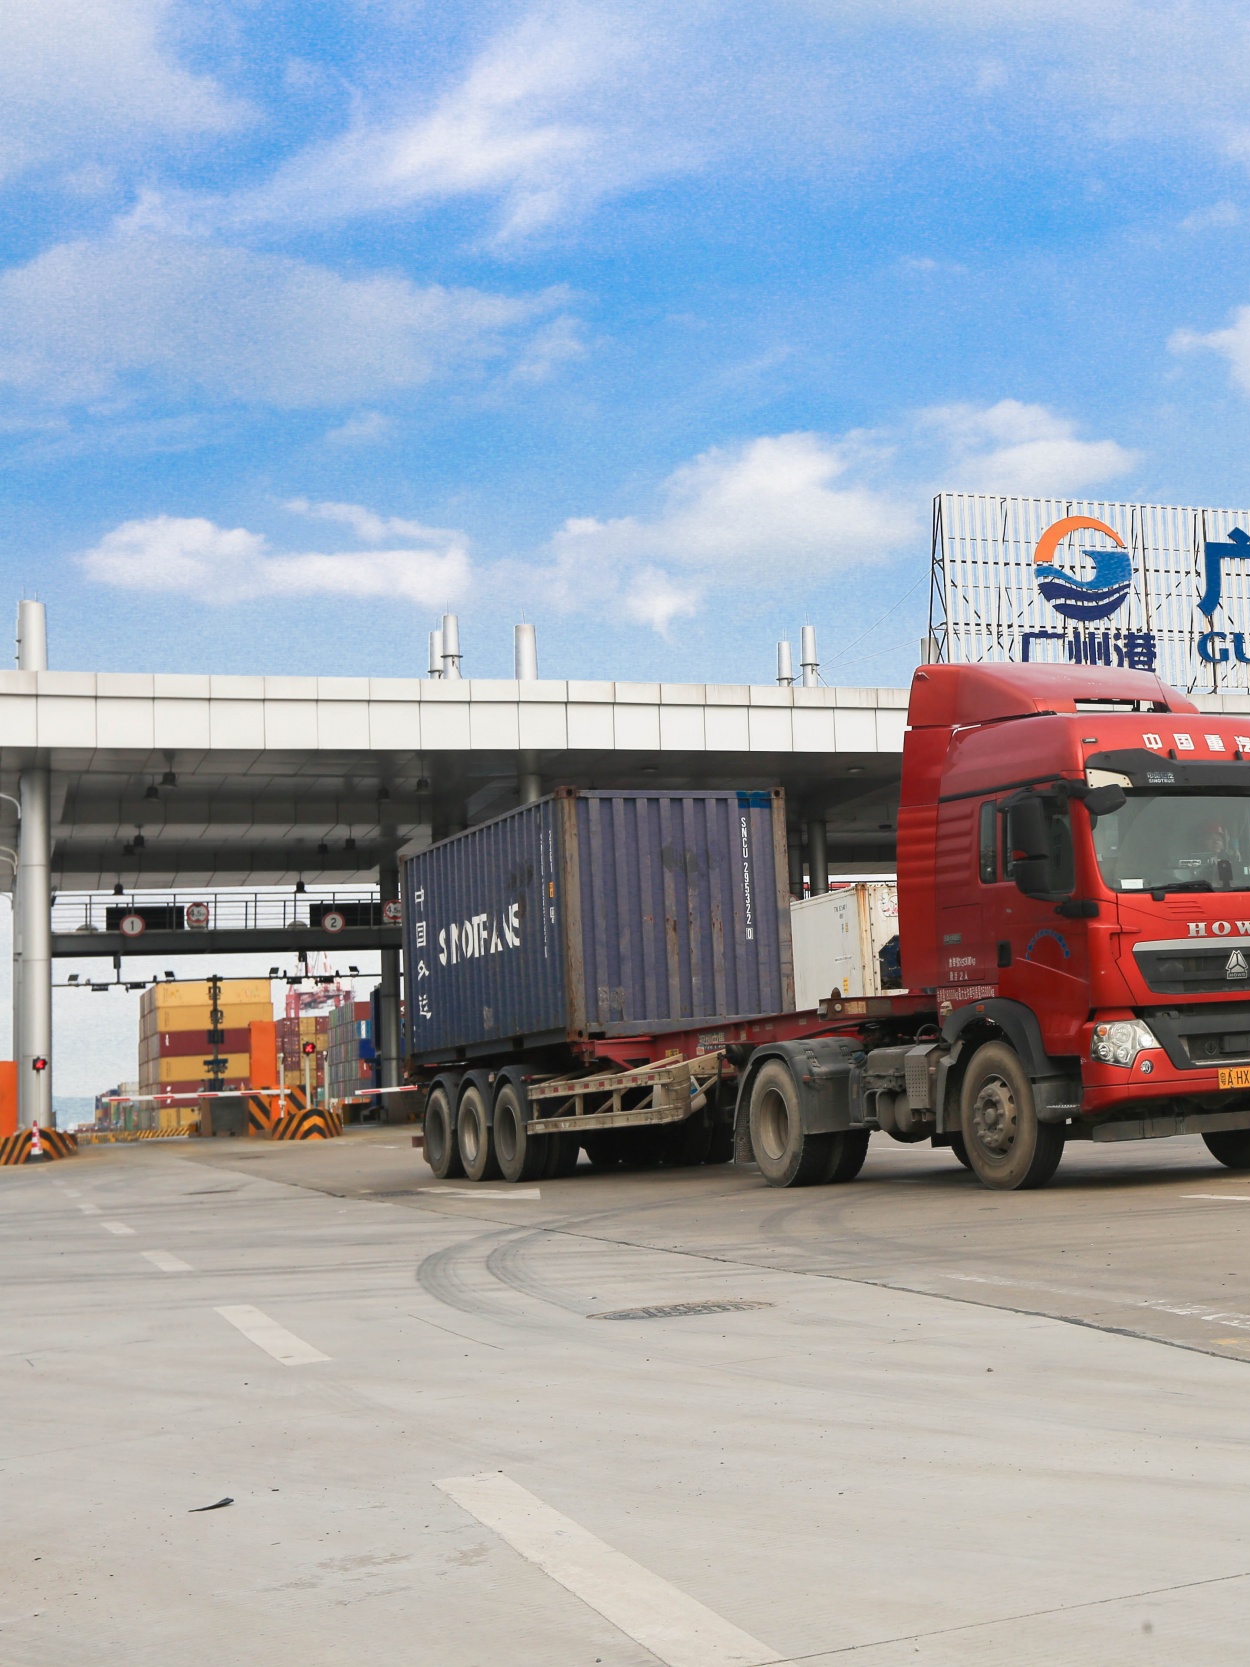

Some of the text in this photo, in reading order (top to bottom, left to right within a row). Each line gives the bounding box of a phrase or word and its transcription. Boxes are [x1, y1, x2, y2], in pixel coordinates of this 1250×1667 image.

[1021, 630, 1157, 673] 广州港
[740, 816, 749, 858] SNCU
[743, 862, 752, 925] 295322
[130, 919, 135, 931] 1
[330, 917, 337, 928] 2
